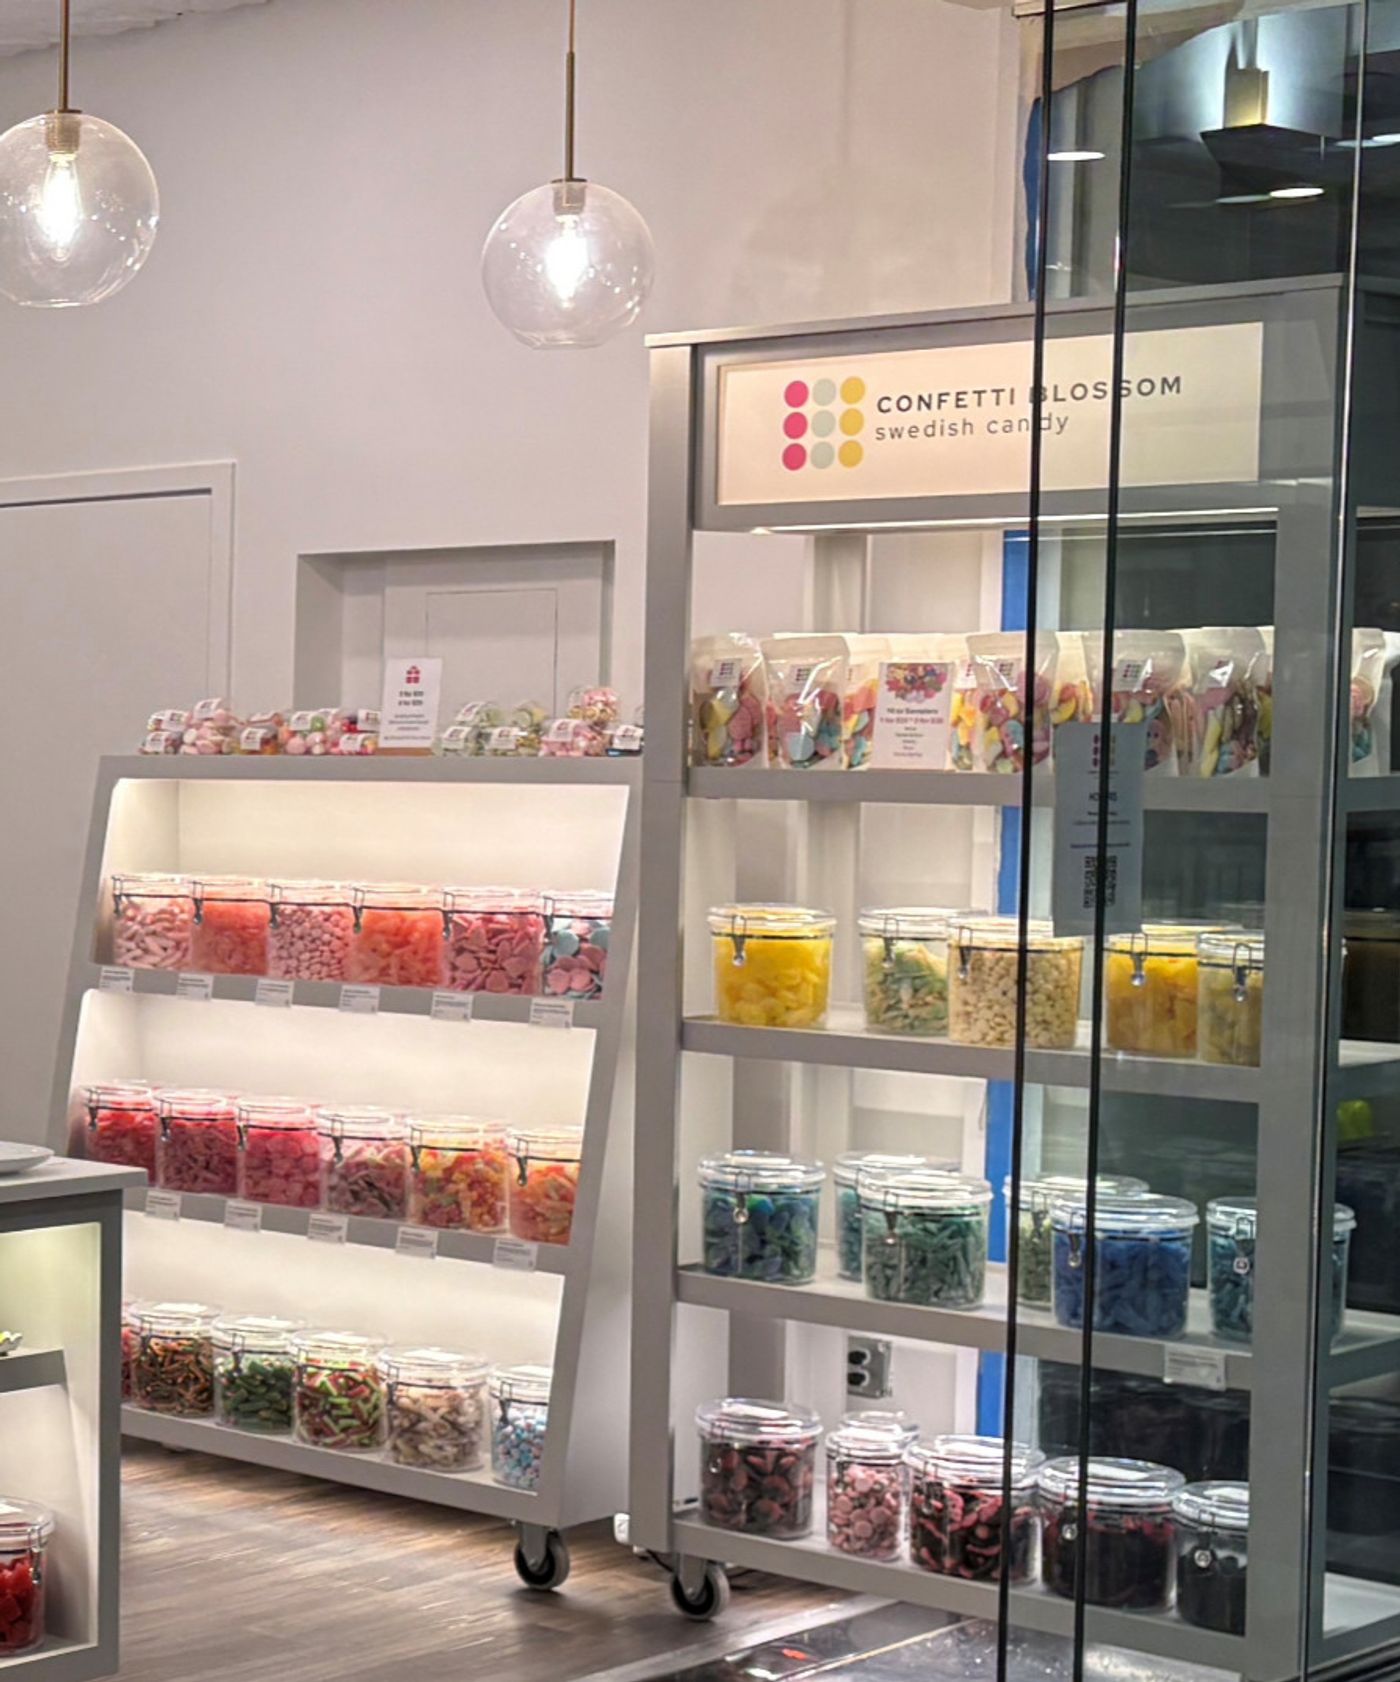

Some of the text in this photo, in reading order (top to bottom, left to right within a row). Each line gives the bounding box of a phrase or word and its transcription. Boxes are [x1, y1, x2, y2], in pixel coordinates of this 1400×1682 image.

[877, 387, 1015, 414] CONFETTI
[875, 412, 1069, 441] swedish candy
